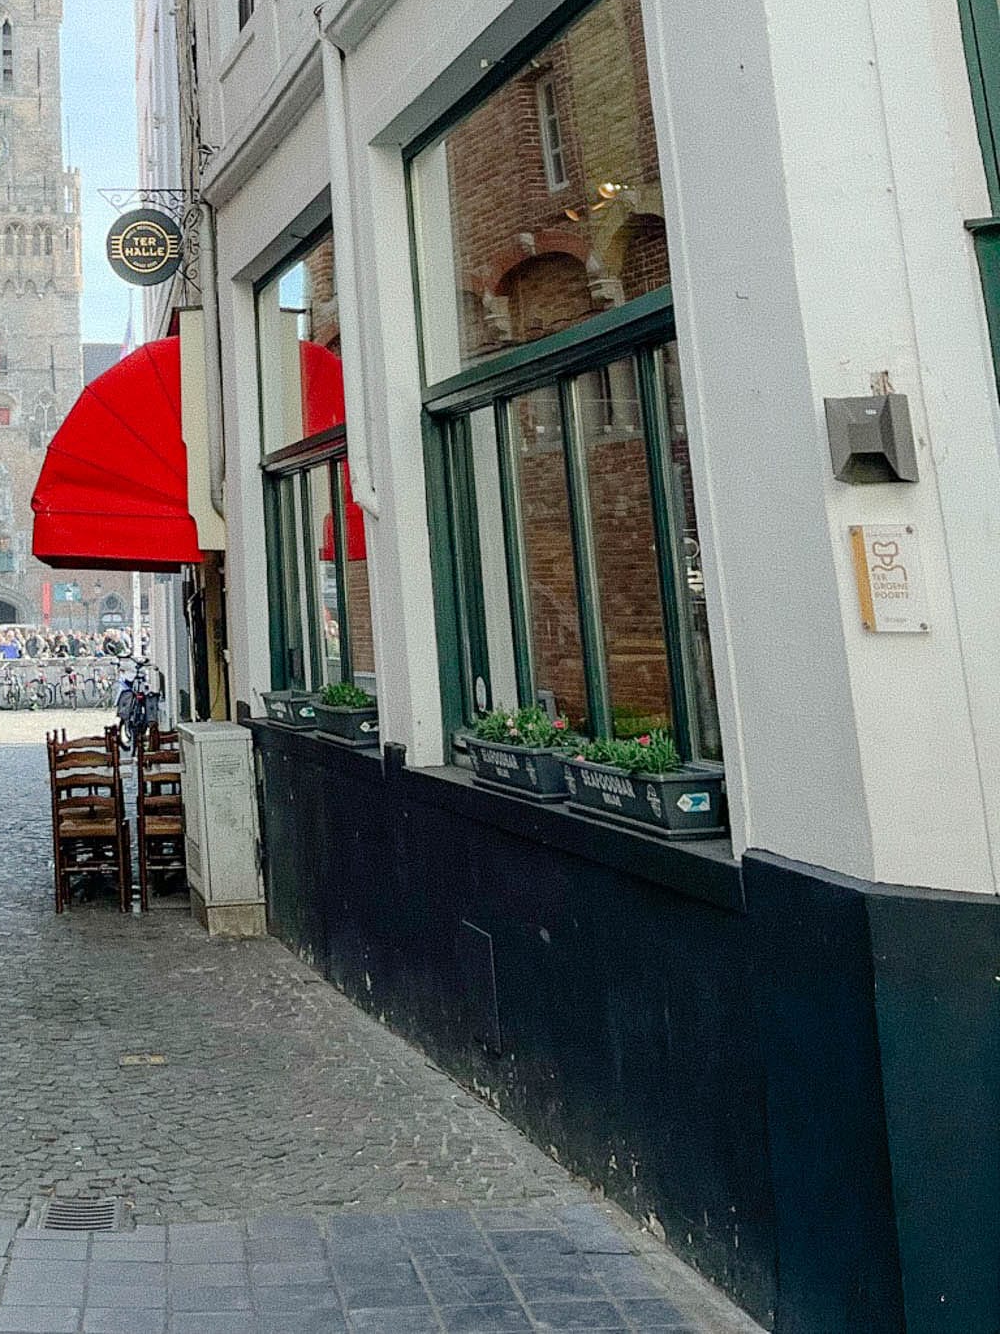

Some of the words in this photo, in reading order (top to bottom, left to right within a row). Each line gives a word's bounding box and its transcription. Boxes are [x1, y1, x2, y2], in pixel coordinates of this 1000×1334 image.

[132, 237, 157, 247] TER
[125, 247, 166, 257] HALLE
[580, 768, 636, 799] SEAFOODBAR
